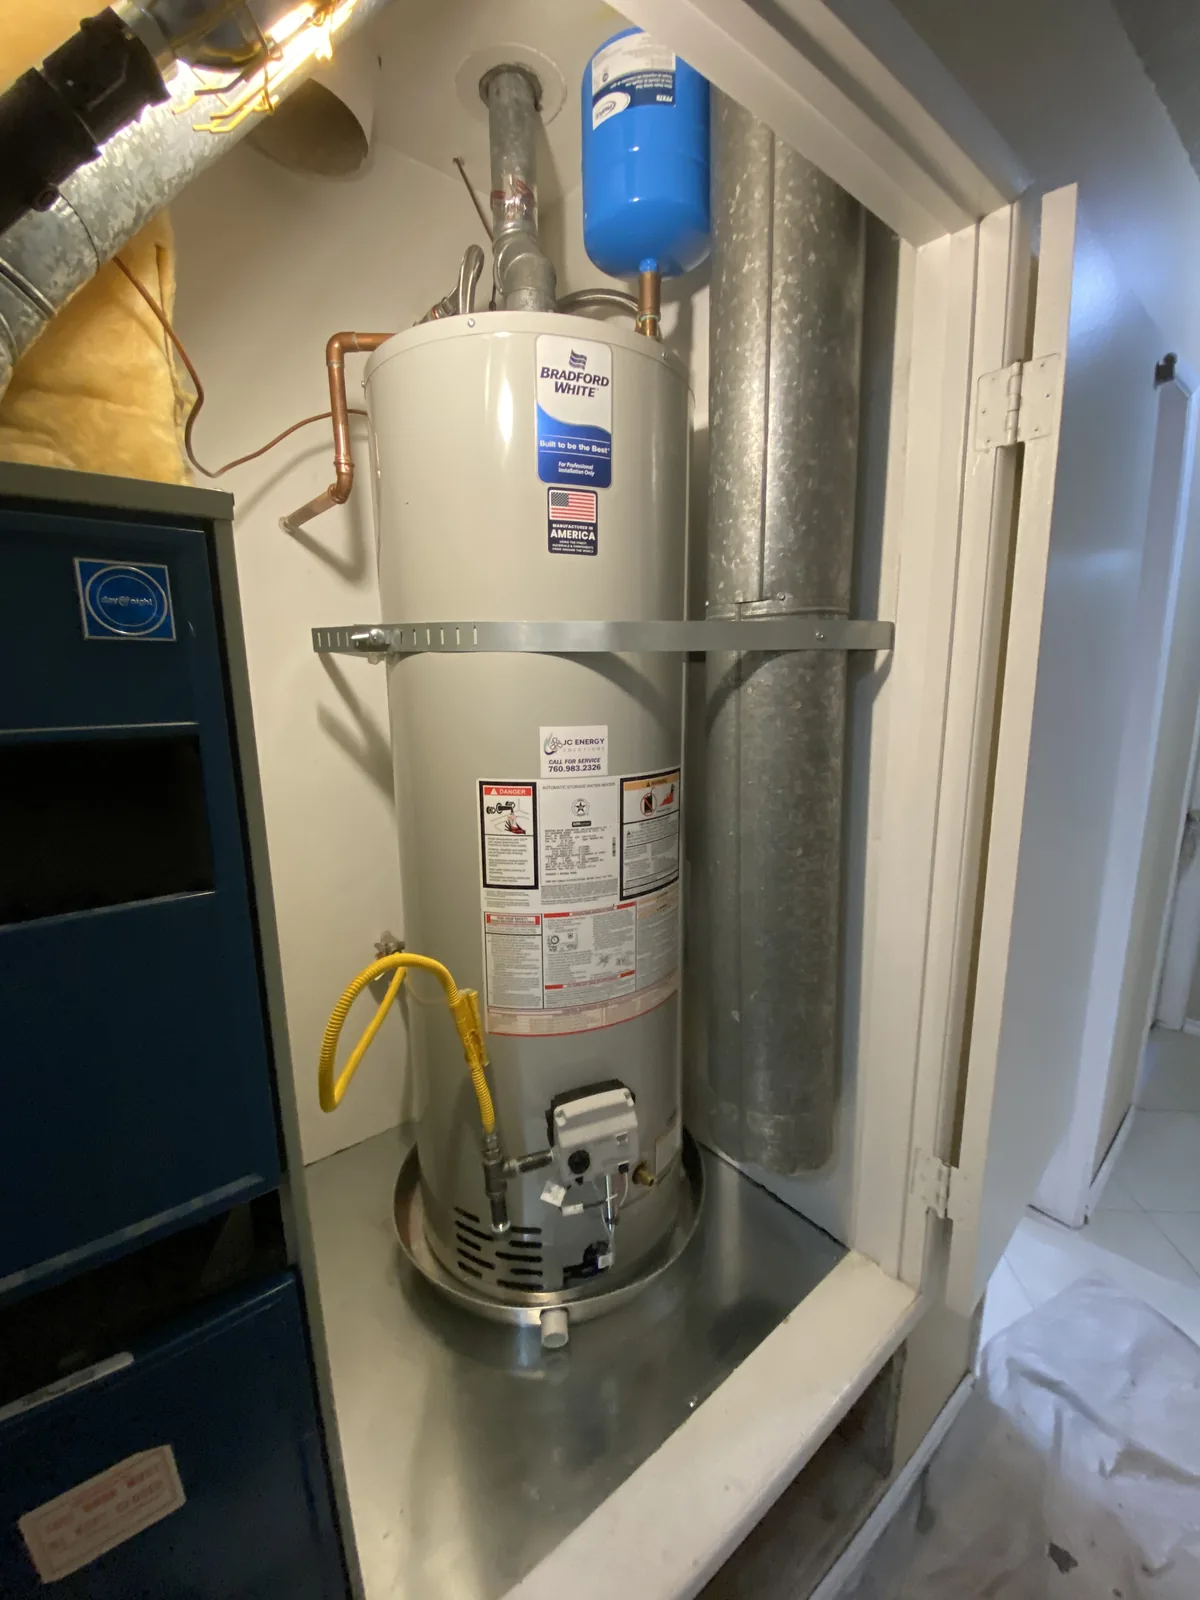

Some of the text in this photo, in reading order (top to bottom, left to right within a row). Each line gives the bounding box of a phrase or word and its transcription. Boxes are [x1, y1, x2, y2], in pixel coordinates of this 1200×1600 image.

[540, 367, 610, 387] BRADFORD
[554, 381, 596, 398] WHITE
[540, 440, 556, 448] Built
[558, 441, 566, 449] to
[567, 442, 577, 450] be
[578, 443, 590, 452] the
[558, 467, 583, 475] Installation
[567, 462, 594, 470] Professional
[550, 529, 596, 541] AMERICA
[575, 738, 605, 746] ENERGY
[548, 764, 601, 773] 760.983.2326
